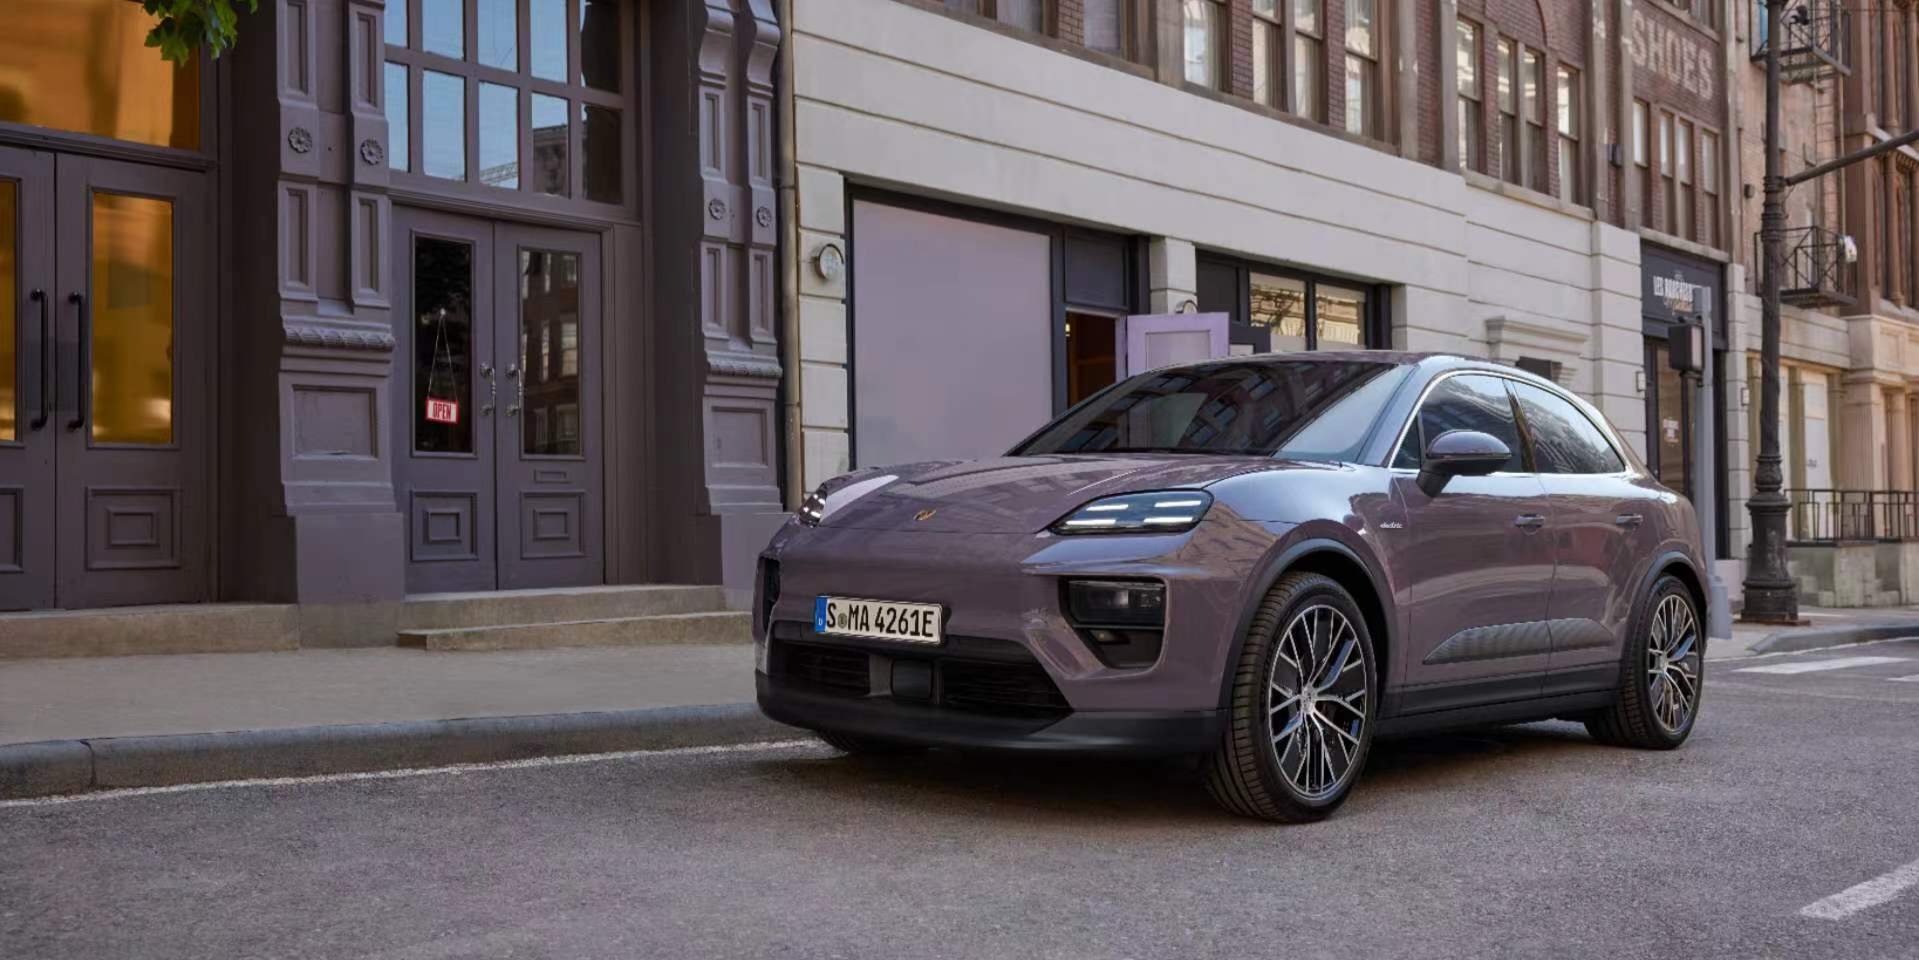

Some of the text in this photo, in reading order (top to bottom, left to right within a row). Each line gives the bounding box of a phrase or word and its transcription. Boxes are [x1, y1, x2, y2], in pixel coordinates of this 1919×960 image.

[1631, 9, 1712, 99] SHOES
[432, 402, 451, 420] OPEN
[827, 603, 935, 637] S MA 4261E
